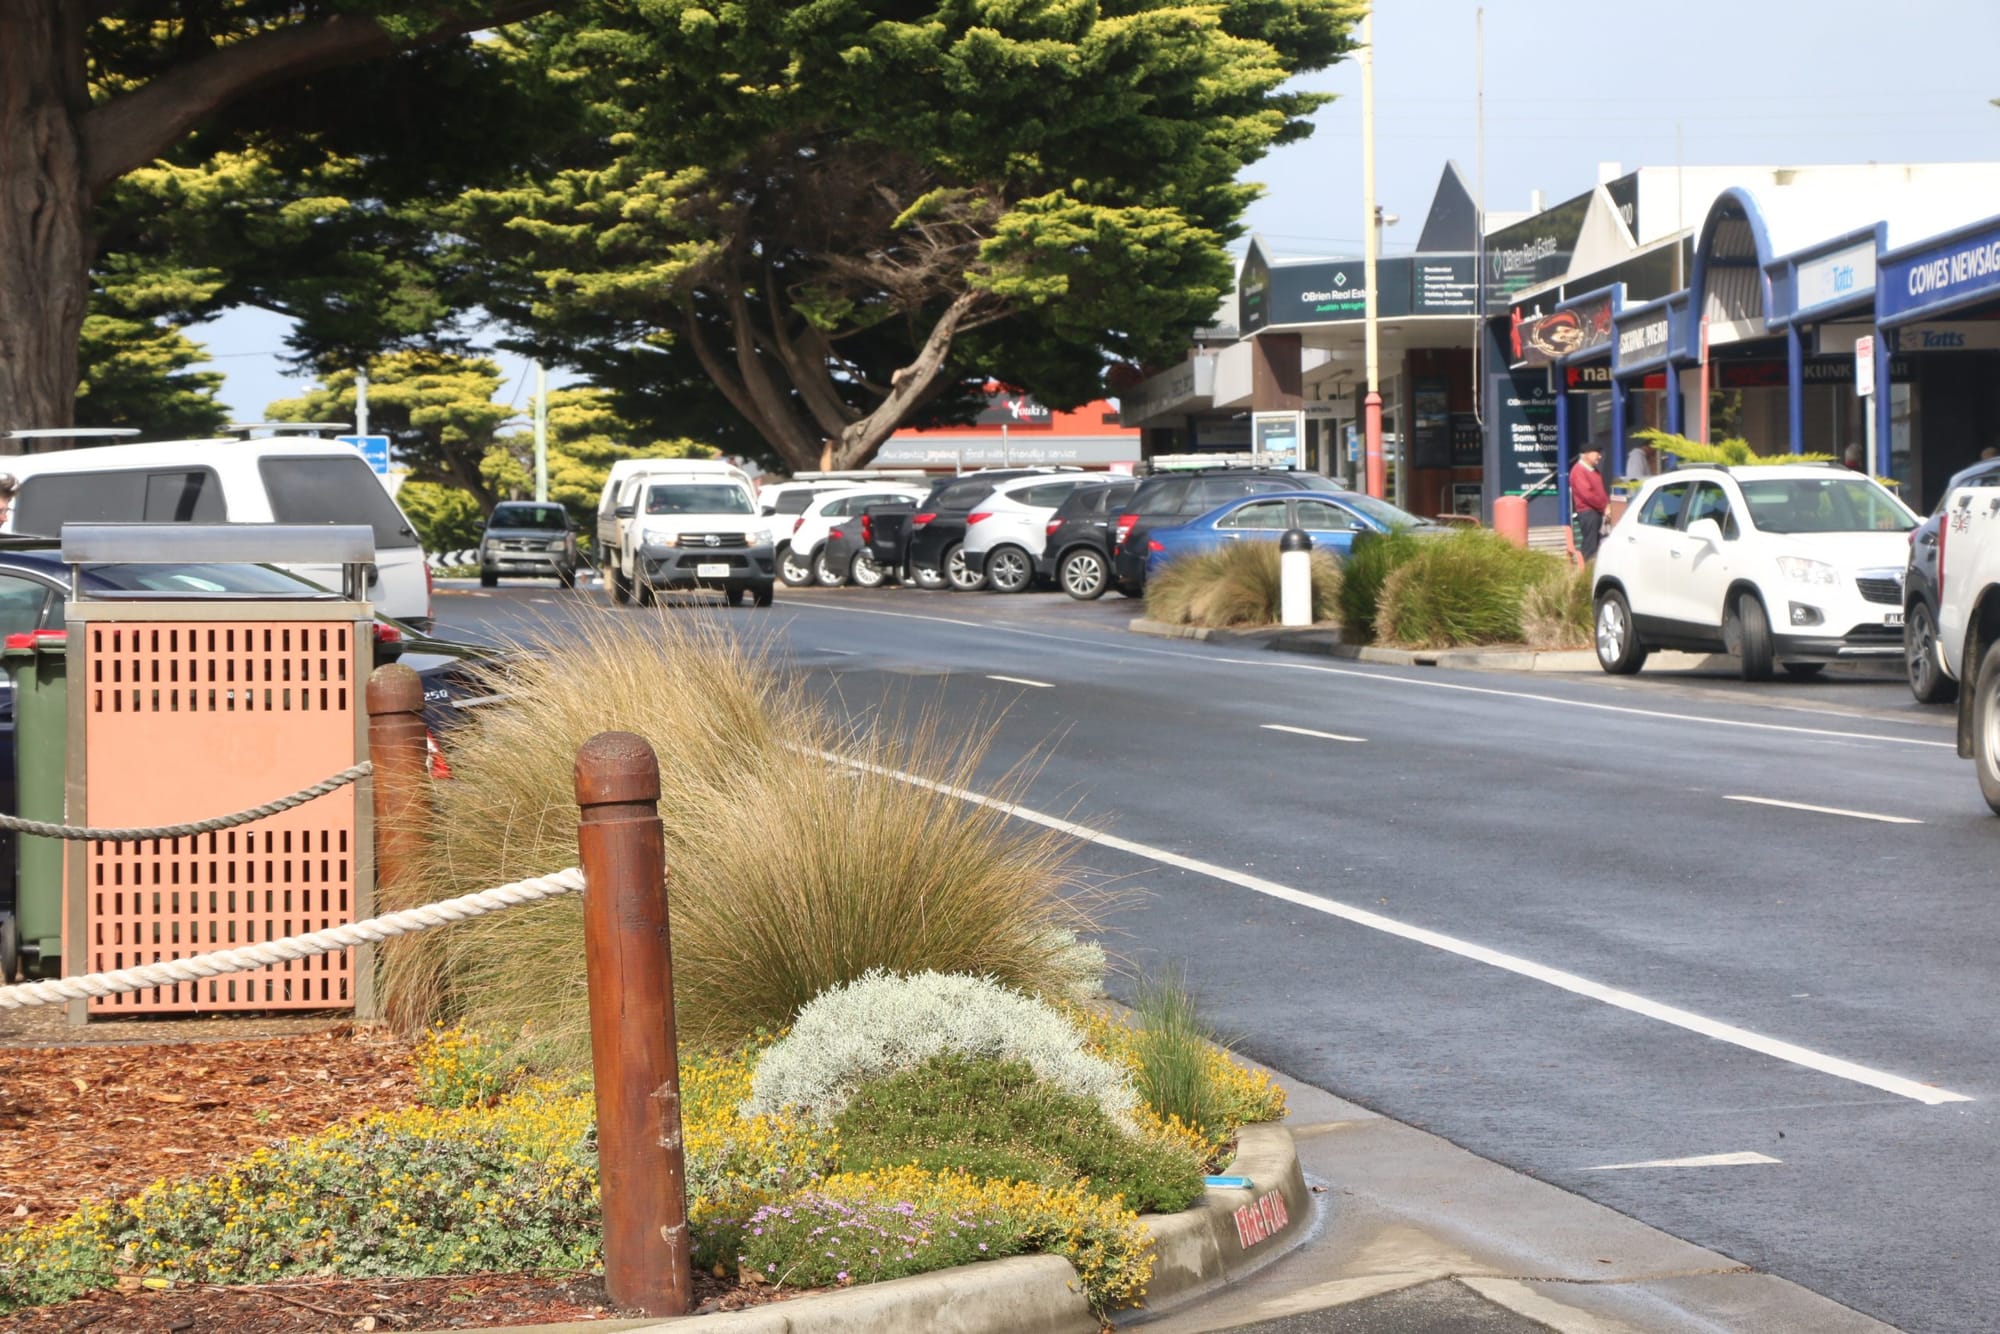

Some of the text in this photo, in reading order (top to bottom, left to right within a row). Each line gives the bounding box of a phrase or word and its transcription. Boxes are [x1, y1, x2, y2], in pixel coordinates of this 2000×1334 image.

[1832, 264, 1855, 293] Tatts
[1909, 257, 1951, 297] COWES
[1302, 291, 1331, 302] OBrien
[1331, 289, 1350, 300] Real
[1921, 330, 1966, 348] Tatts
[1511, 423, 1536, 433] Same
[1512, 433, 1537, 442] Same
[1513, 444, 1534, 452] New
[424, 689, 448, 702] 250
